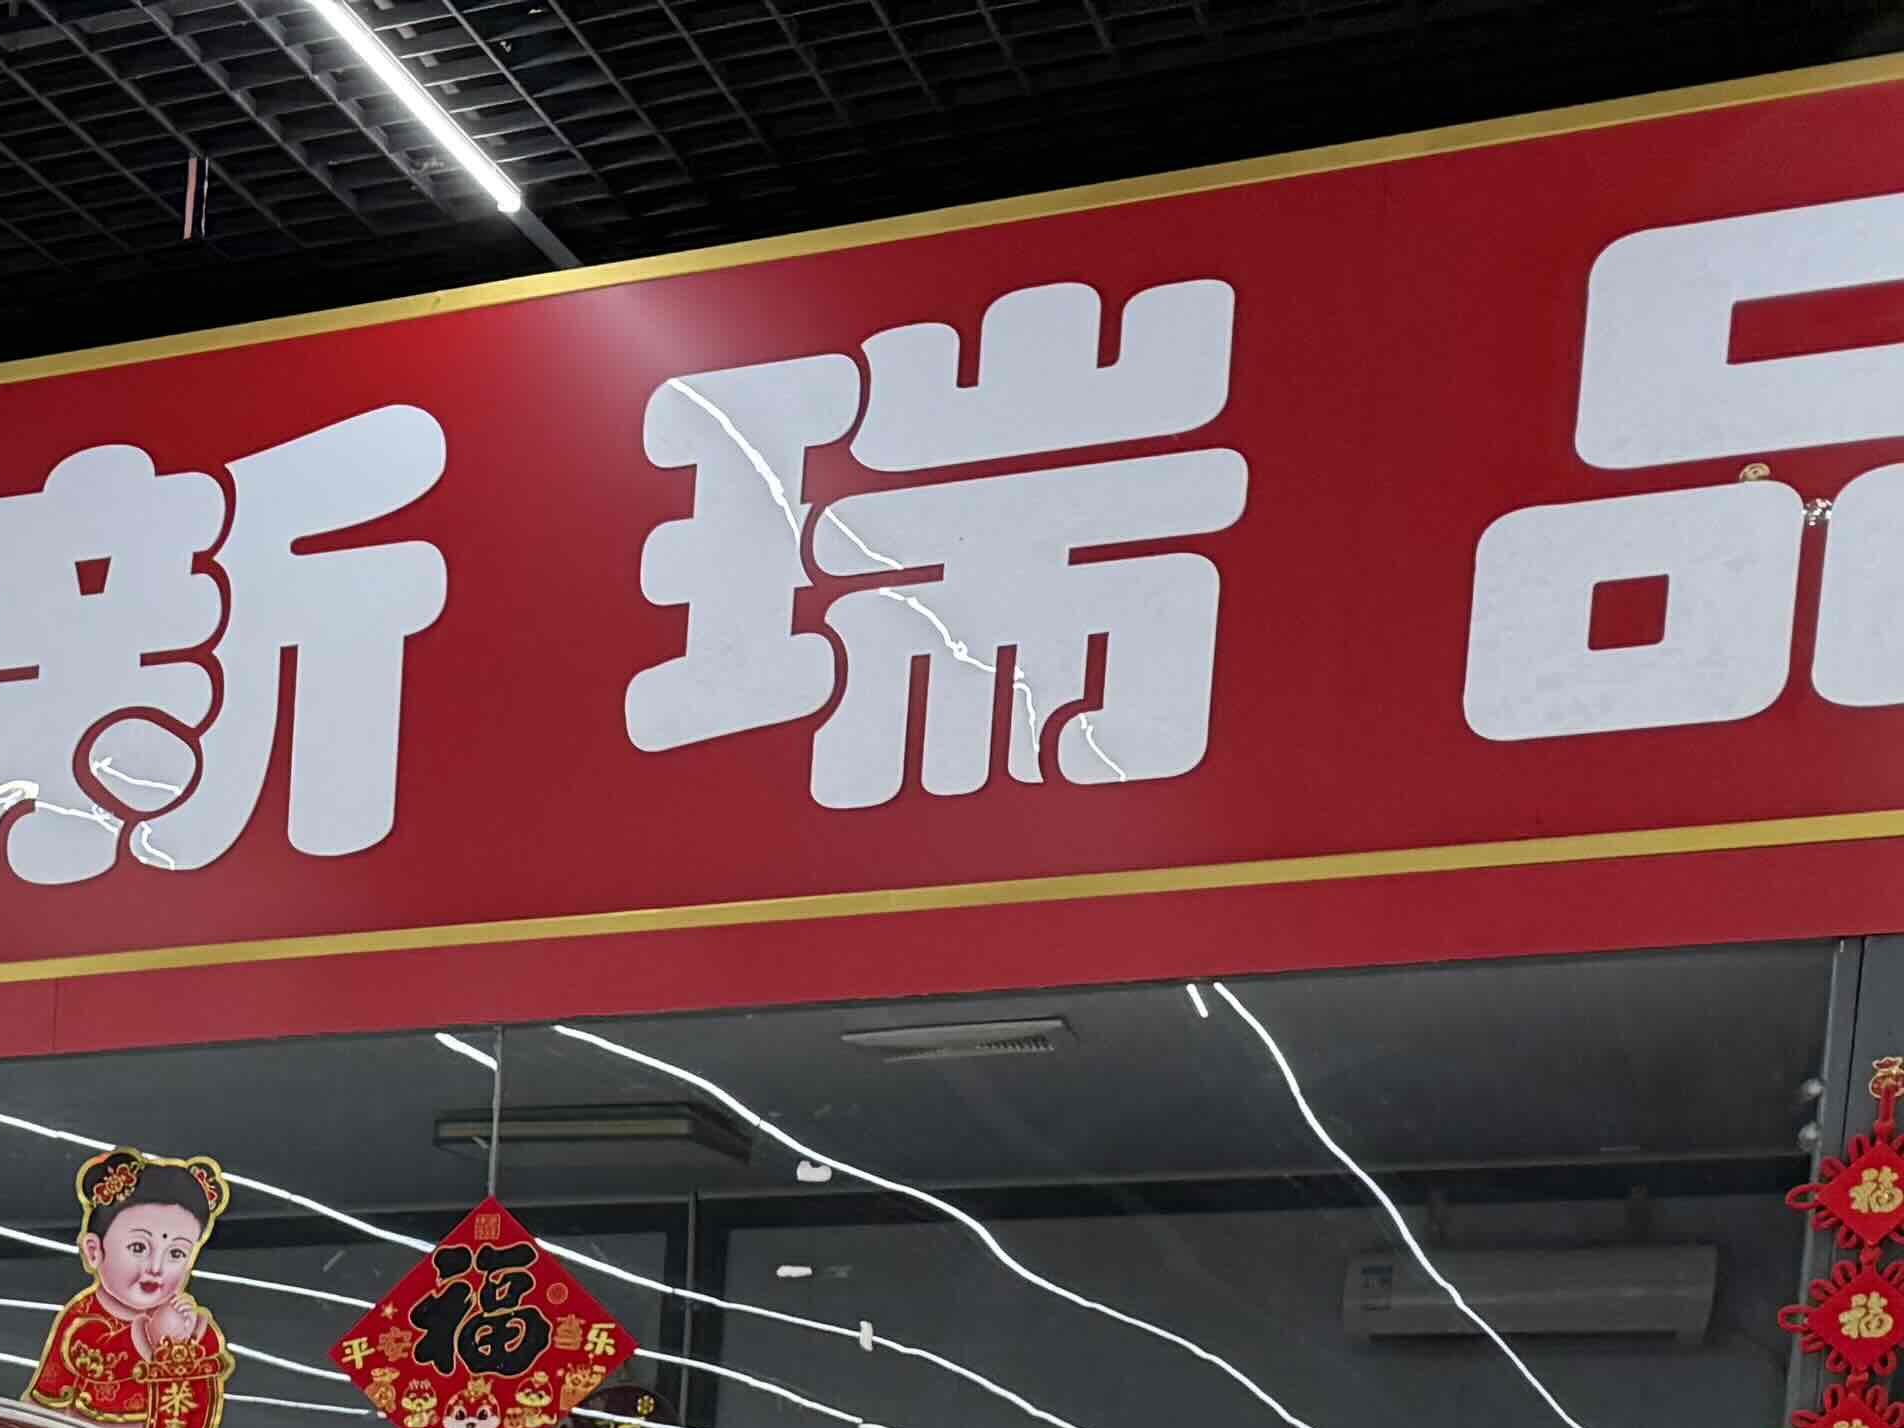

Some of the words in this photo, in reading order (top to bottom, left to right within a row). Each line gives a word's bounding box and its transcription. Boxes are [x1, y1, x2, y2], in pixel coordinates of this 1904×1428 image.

[1848, 1165, 1904, 1214] 福
[407, 1241, 554, 1379] 福
[1838, 1291, 1894, 1339] 福
[341, 1326, 414, 1370] 平安
